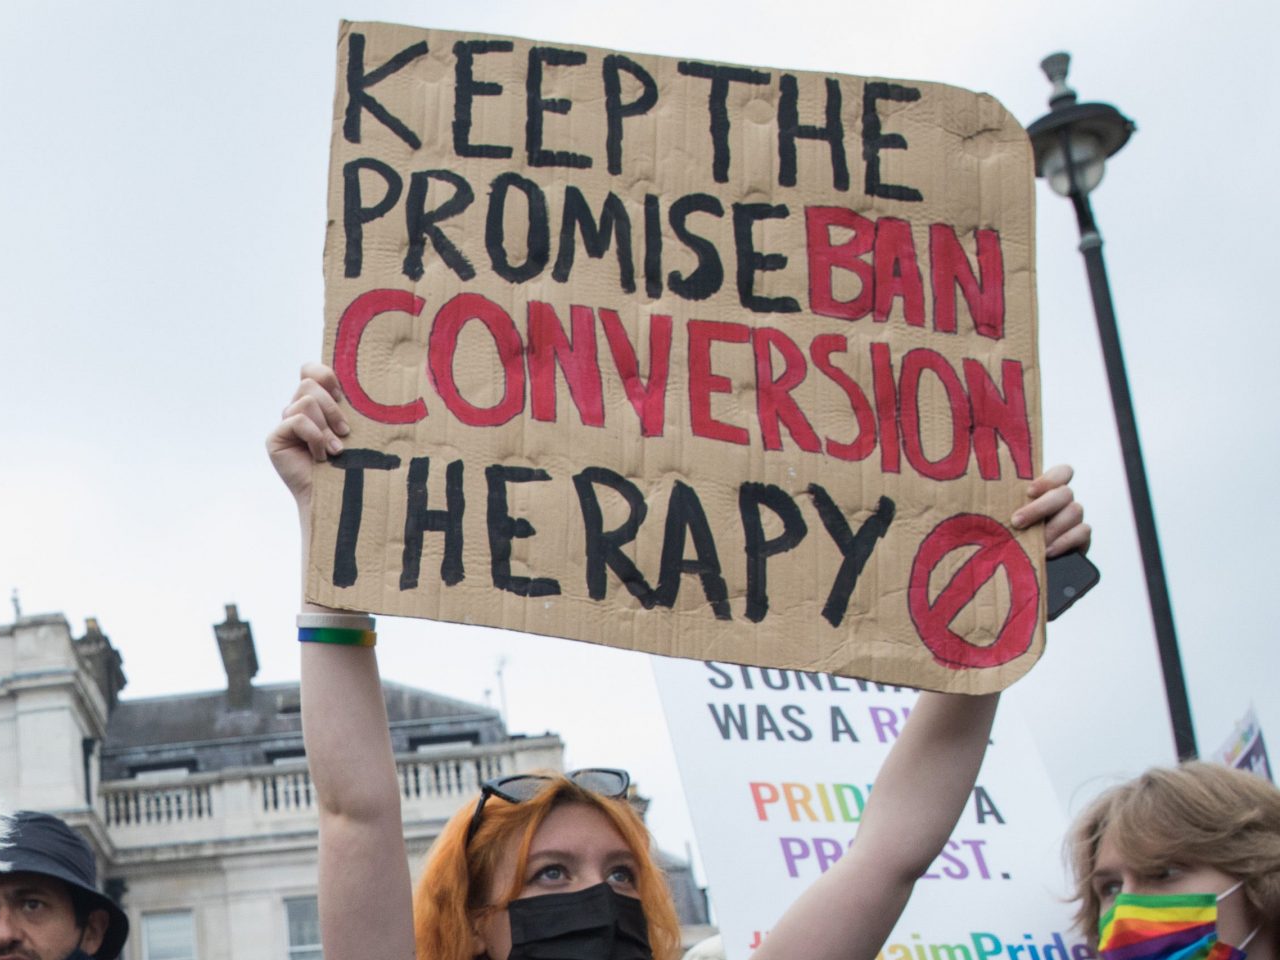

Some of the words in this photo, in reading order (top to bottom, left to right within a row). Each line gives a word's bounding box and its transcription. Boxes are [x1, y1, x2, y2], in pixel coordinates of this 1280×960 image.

[342, 32, 660, 175] KEEP
[678, 60, 923, 202] THE
[342, 157, 802, 314] PROMISE
[804, 205, 1006, 340] BAN
[333, 288, 1034, 482] CONVERSION
[328, 446, 897, 629] THERAPY
[707, 703, 813, 742] WAS
[830, 706, 860, 743] A
[749, 782, 872, 822] PRID
[974, 786, 1005, 824] A
